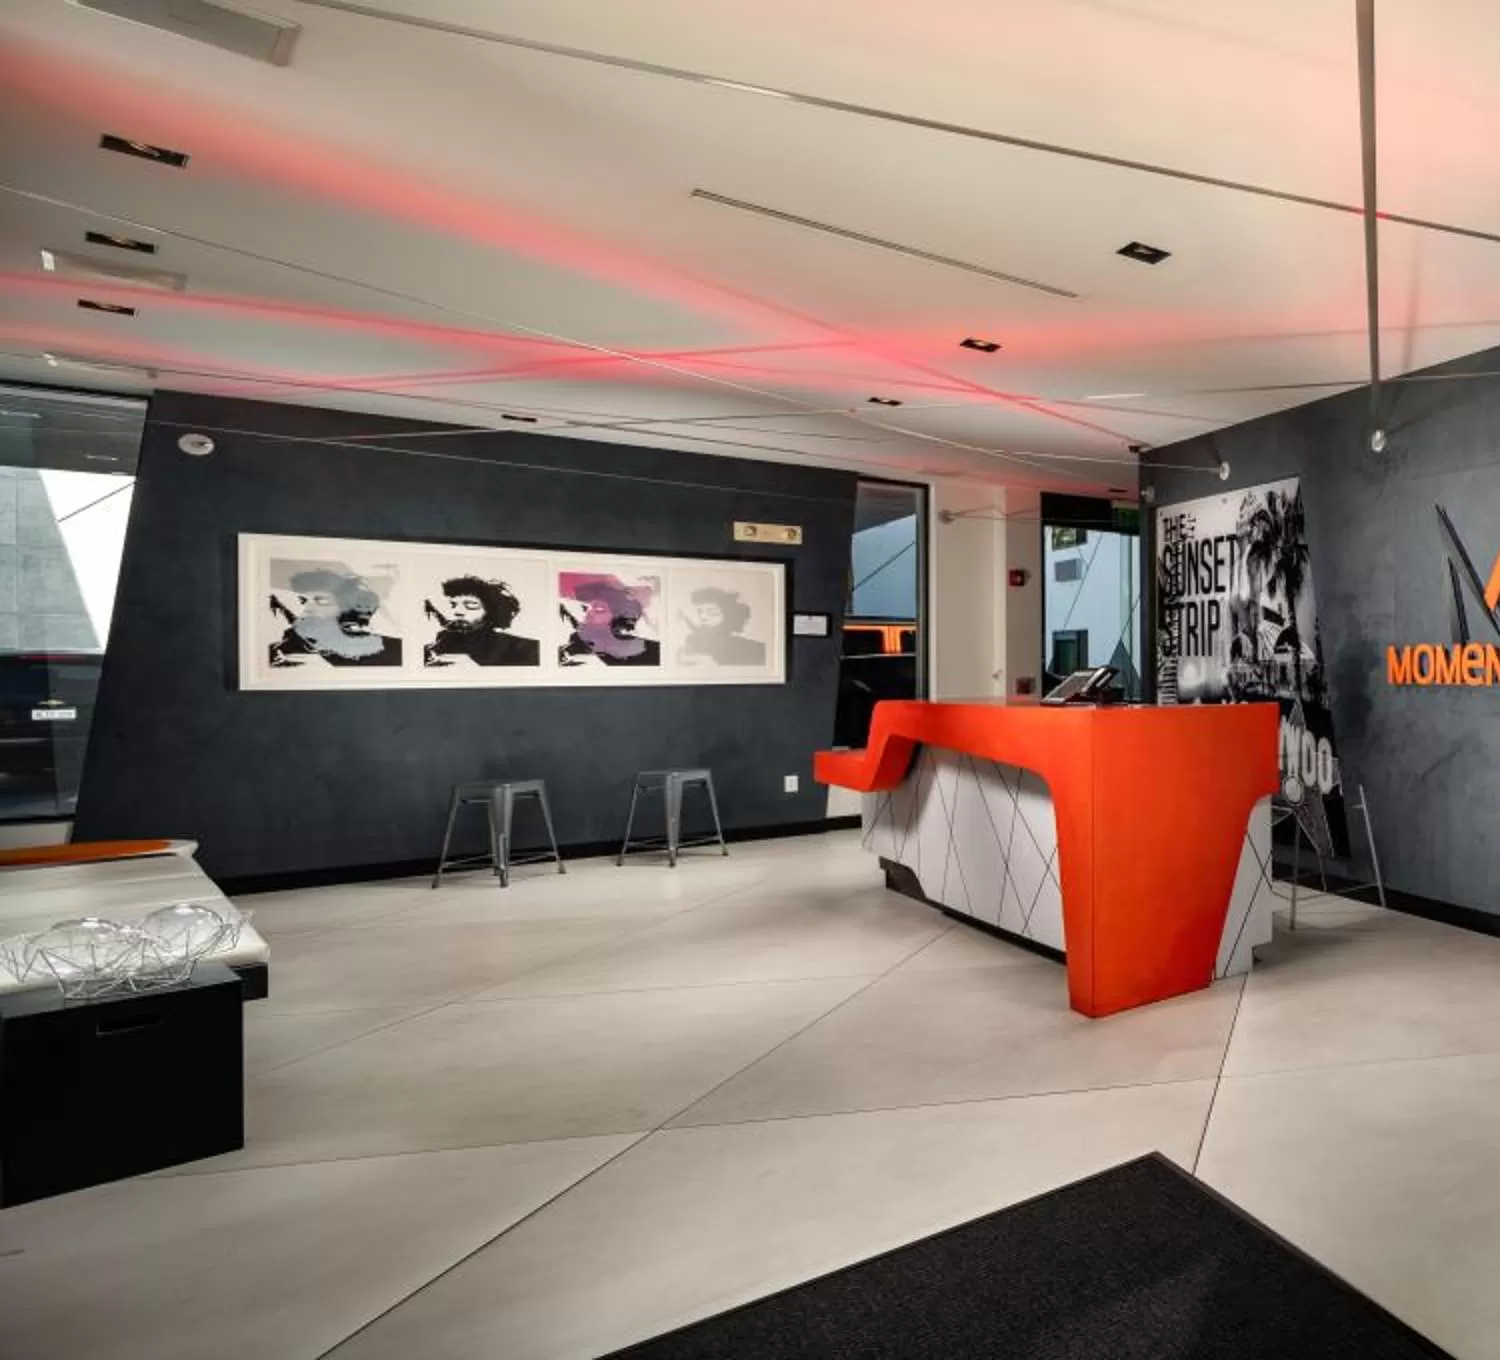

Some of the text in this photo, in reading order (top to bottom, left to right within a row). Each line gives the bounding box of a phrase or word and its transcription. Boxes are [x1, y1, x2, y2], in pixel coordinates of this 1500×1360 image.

[1163, 513, 1188, 543] THE
[1162, 534, 1238, 598] SUNSET
[1162, 600, 1220, 657] STRIP
